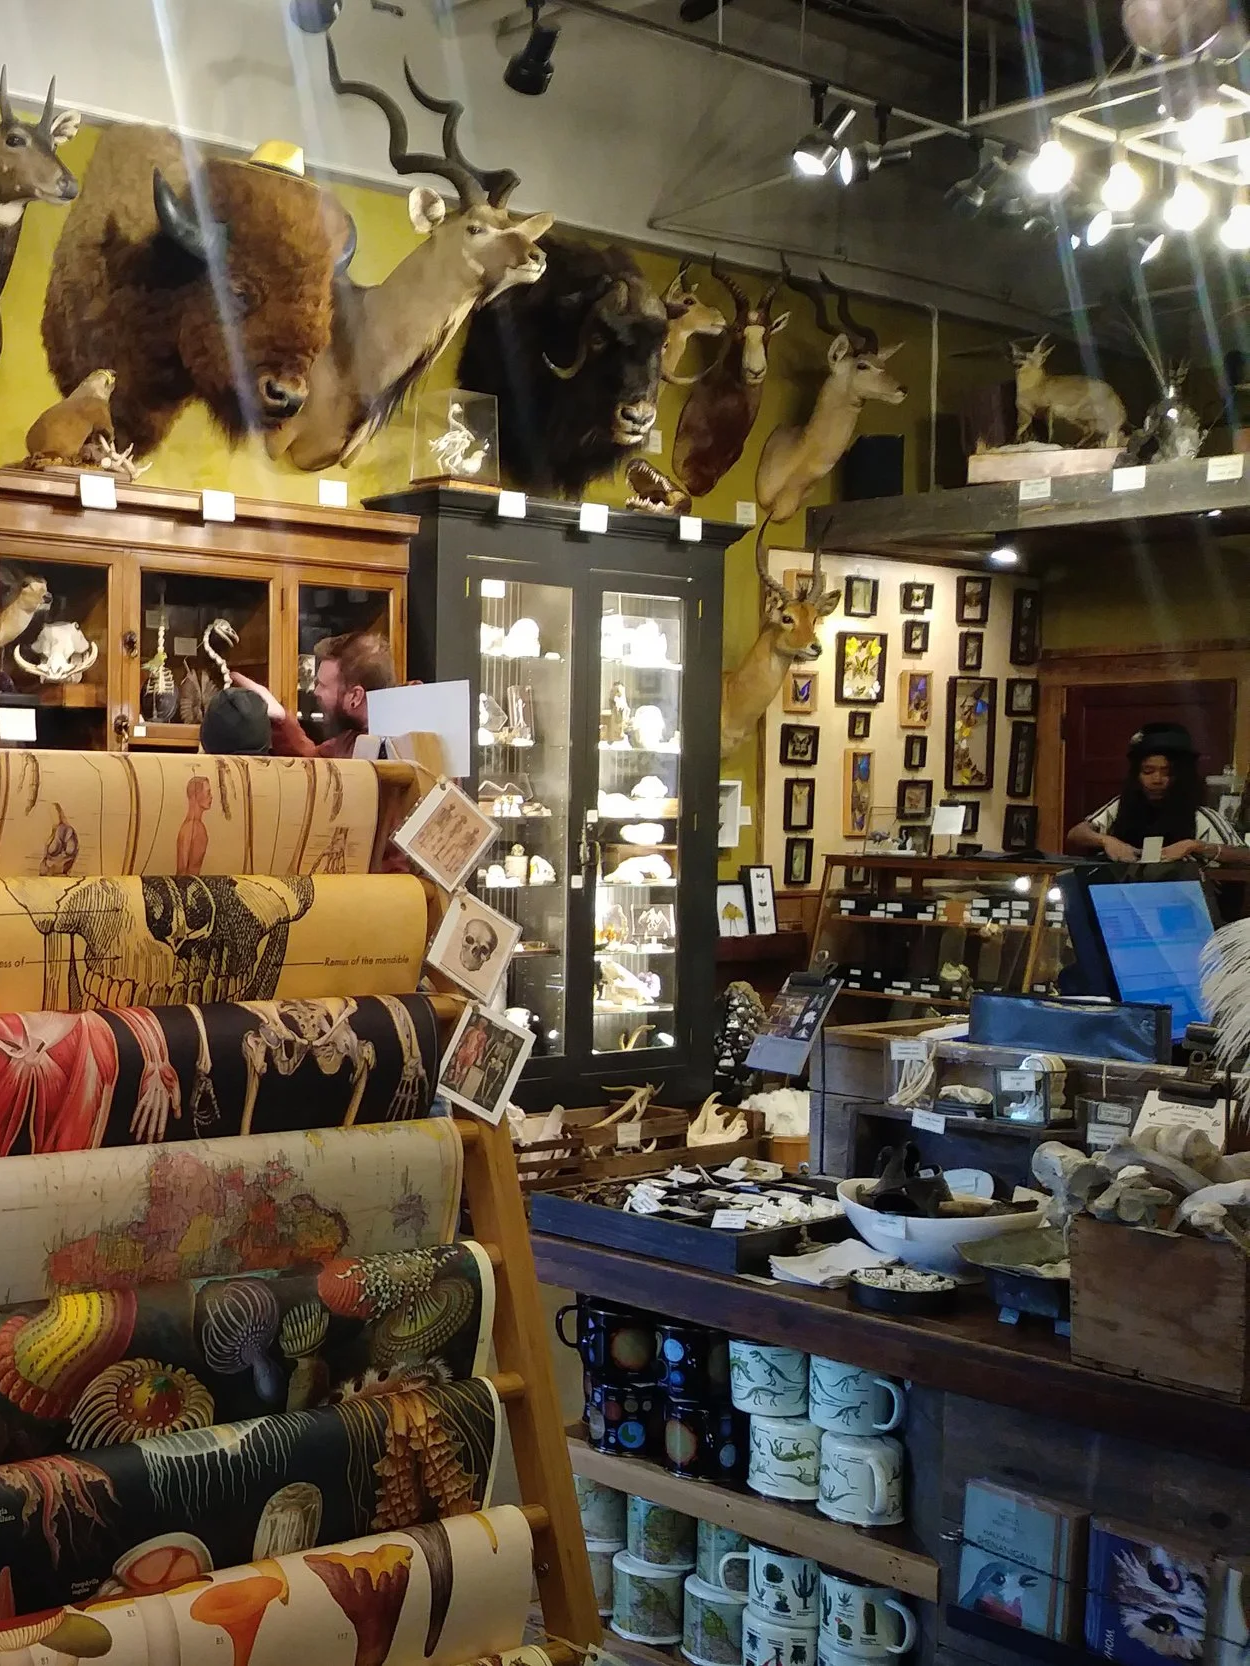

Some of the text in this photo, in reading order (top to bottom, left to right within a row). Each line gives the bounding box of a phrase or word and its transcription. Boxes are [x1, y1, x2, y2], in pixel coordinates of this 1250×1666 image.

[13, 957, 25, 968] of
[350, 955, 360, 966] of
[361, 955, 374, 965] the
